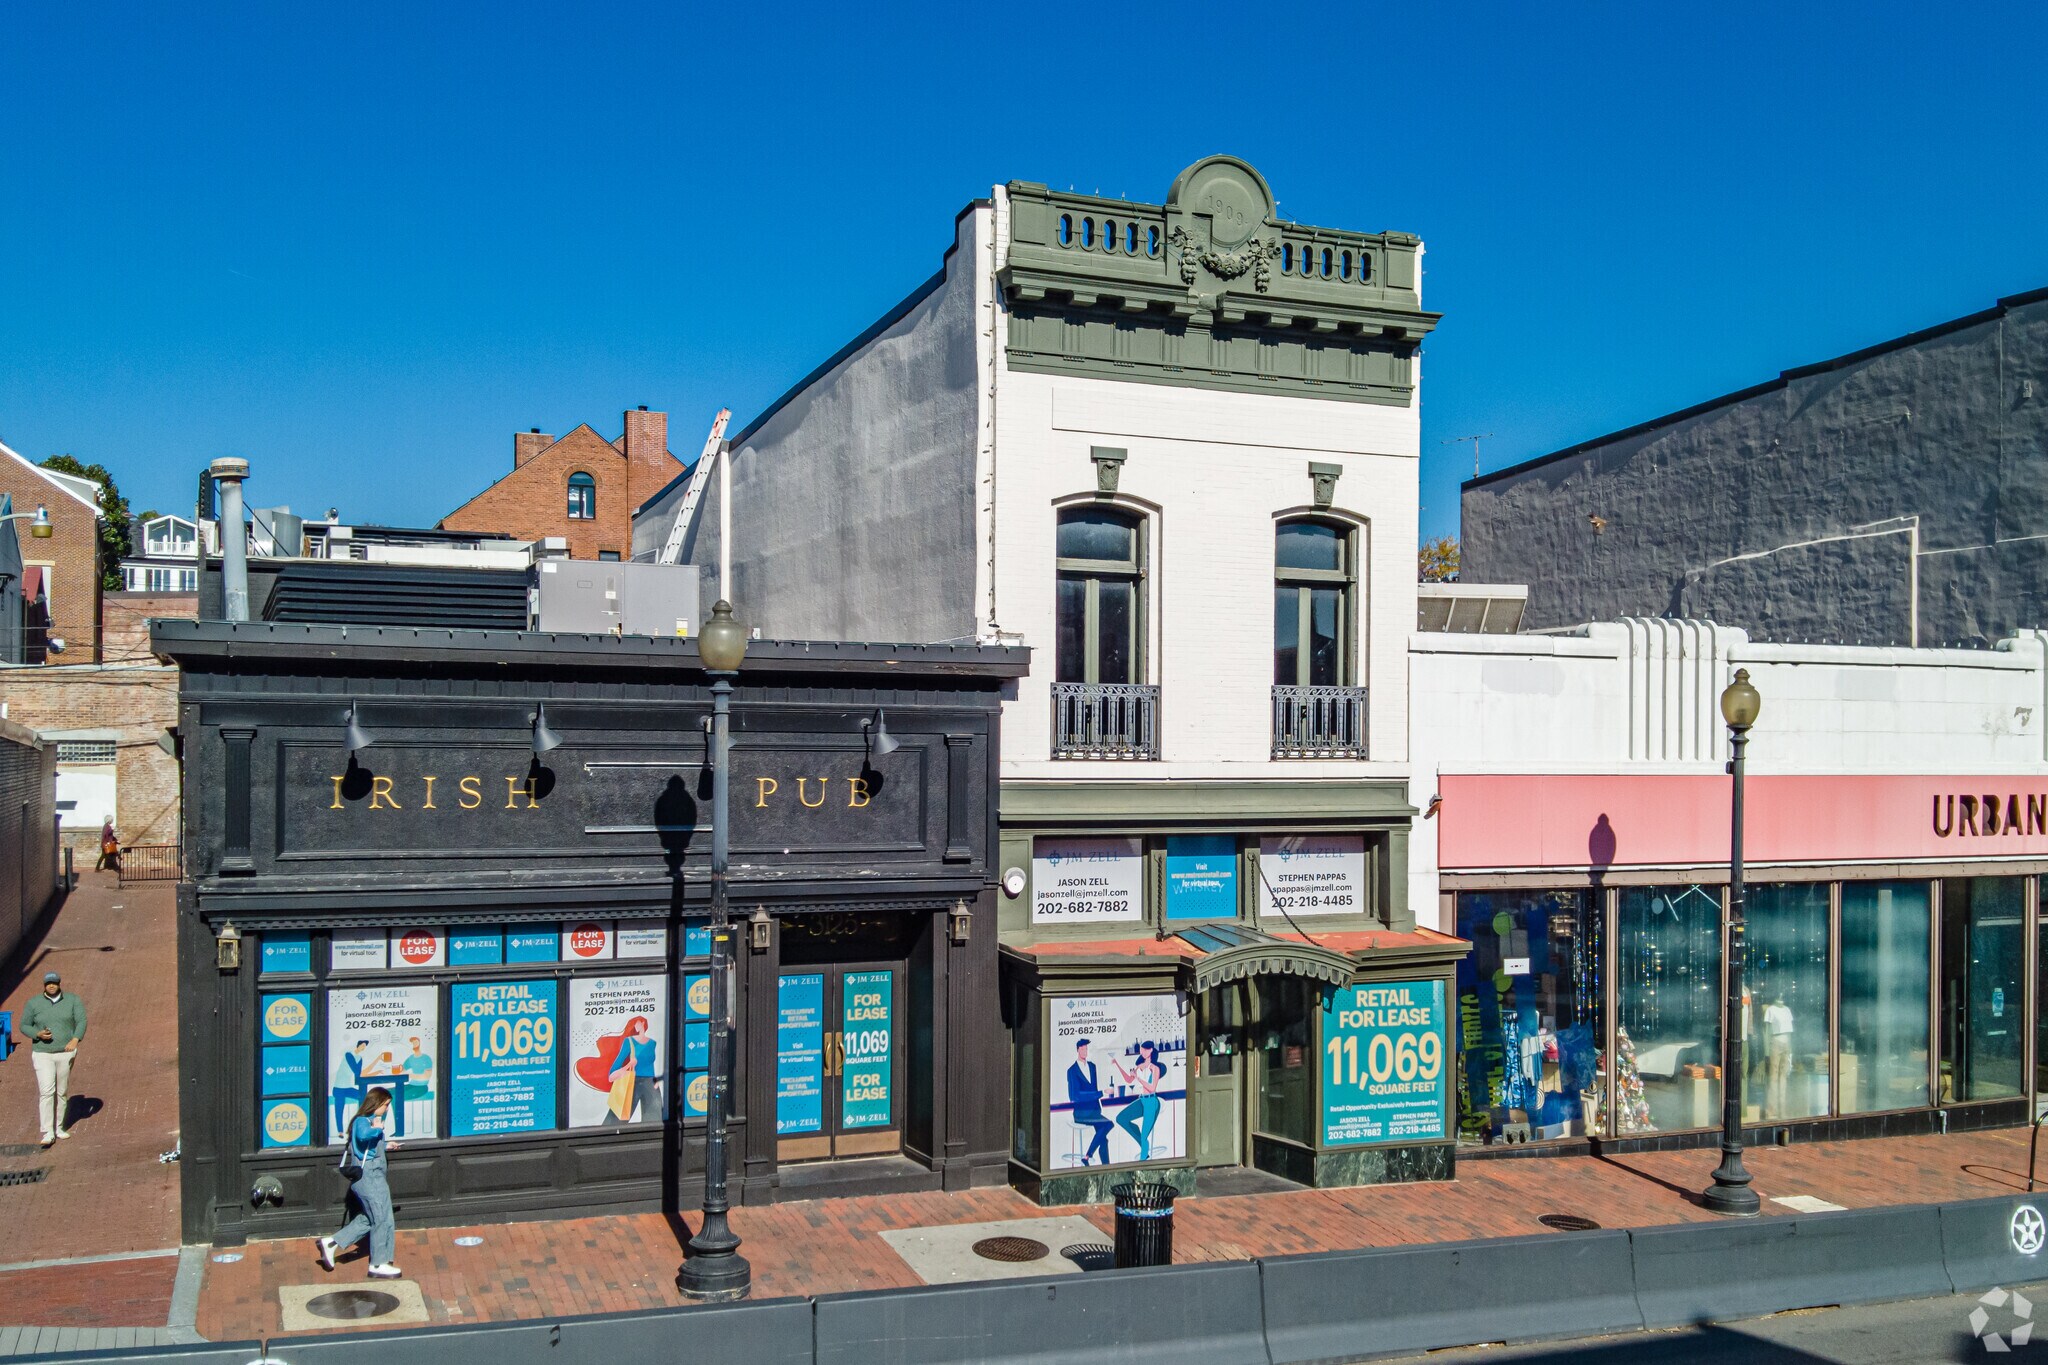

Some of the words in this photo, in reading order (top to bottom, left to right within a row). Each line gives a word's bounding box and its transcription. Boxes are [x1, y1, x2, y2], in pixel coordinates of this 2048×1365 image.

[329, 776, 540, 810] IRISH
[755, 776, 872, 809] PUB
[1932, 793, 2047, 838] URBAN
[1057, 878, 1087, 887] JASON
[1089, 878, 1109, 886] ZELL
[1181, 879, 1190, 887] for
[1278, 873, 1315, 882] STEPHEN
[1316, 873, 1347, 881] PAPPAS
[1272, 883, 1352, 894] spappas@jmzell.com
[1037, 889, 1128, 900] jasonzell@jmzell.com
[1037, 900, 1129, 914] 202-682-7882
[1271, 895, 1353, 908] 202-218-4485
[577, 930, 599, 939] FOR
[407, 936, 429, 945] FOR
[572, 939, 604, 949] LEASE
[401, 945, 436, 956] LEASE
[477, 984, 532, 1001] RETAIL
[590, 991, 622, 999] STEPHEN
[623, 989, 651, 997] PAPPAS
[696, 985, 709, 993] FO
[584, 996, 656, 1006] spappas@jmzell.com
[690, 996, 709, 1005] LEA
[853, 993, 882, 1007] FOR
[1356, 989, 1414, 1007] RETAIL
[274, 1005, 298, 1015] FOR
[345, 1009, 422, 1019] jasonzell@jmzell.com
[461, 1001, 495, 1018] FOR
[498, 999, 549, 1016] LEASE
[584, 1003, 655, 1016] 202-218-4485
[846, 1007, 888, 1021] LEASE
[268, 1016, 305, 1027] LEASE
[1058, 1017, 1117, 1027] jasonzell@jmzell.com
[1339, 1010, 1375, 1028] FOR
[1378, 1008, 1431, 1027] LEASE
[345, 1018, 421, 1030] 202-682-7882
[1058, 1024, 1117, 1036] 202-682-7882
[454, 1016, 554, 1063] 11,069
[844, 1029, 889, 1057] 11,069
[491, 1057, 529, 1067] SQUARE
[530, 1056, 551, 1065] FEET
[845, 1057, 872, 1065] SQUARE
[1327, 1031, 1442, 1091] 11,069
[853, 1073, 881, 1087] FOR
[695, 1082, 708, 1091] FO
[1369, 1083, 1411, 1095] SQUARE
[1412, 1081, 1437, 1092] FEET
[473, 1093, 534, 1104] 202-682-7882
[689, 1093, 707, 1102] LEA
[846, 1087, 888, 1102] LEASE
[478, 1106, 506, 1114] STEPHEN
[1346, 1104, 1377, 1113] Opportunity
[1377, 1102, 1405, 1110] Exclusively
[274, 1110, 298, 1120] FOR
[268, 1121, 305, 1132] LEASE
[473, 1119, 534, 1131] 202-218-4485
[1389, 1124, 1441, 1135] 202-218-4485
[1328, 1129, 1381, 1140] 202-682-7882
